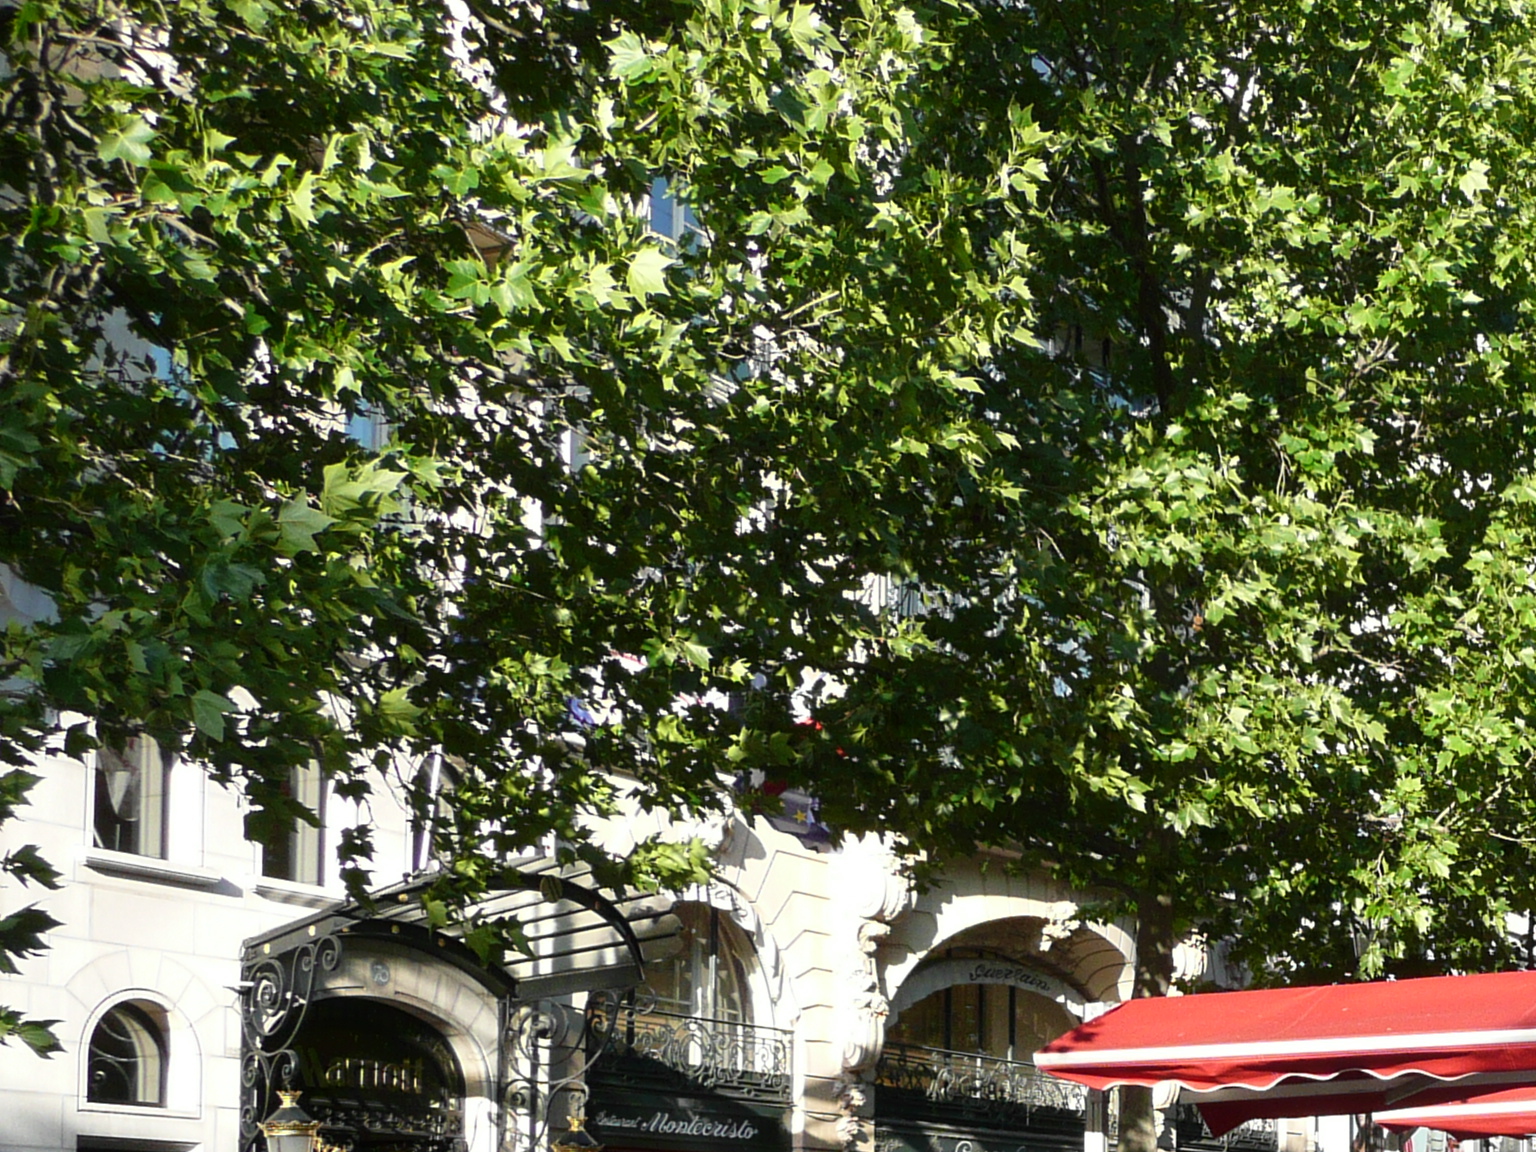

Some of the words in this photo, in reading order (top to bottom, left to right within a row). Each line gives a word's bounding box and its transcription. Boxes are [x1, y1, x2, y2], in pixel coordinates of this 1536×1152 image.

[969, 964, 1051, 992] Guerlain
[294, 1046, 422, 1094] Marriott
[640, 1111, 759, 1140] Montecristo
